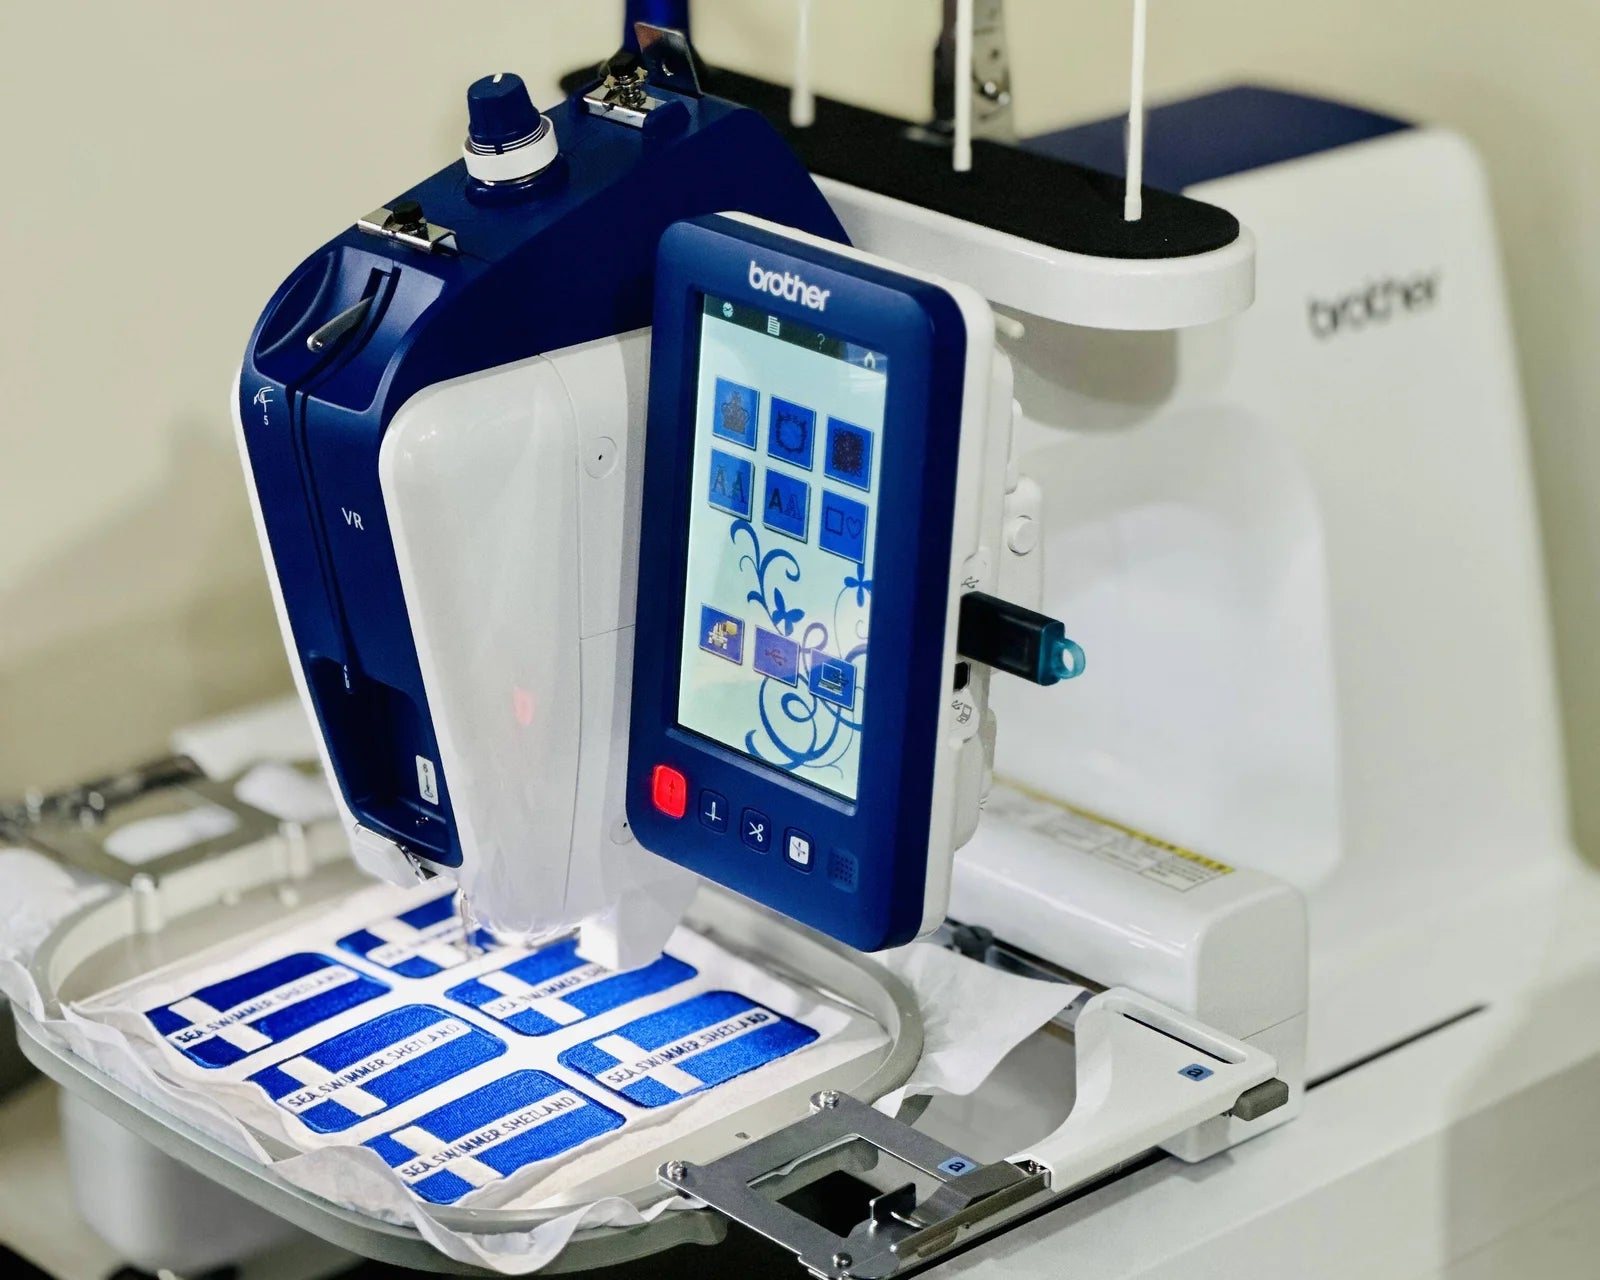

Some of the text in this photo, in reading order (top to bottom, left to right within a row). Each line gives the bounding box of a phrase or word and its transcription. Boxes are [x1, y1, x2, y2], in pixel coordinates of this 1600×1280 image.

[748, 260, 831, 312] brother
[263, 415, 269, 426] 5
[341, 507, 364, 531] VR
[174, 1028, 205, 1044] SEA
[207, 998, 273, 1031] SWIMMER
[287, 1022, 460, 1107] SEA SWIMMER SHETLAND
[607, 1012, 770, 1083] SEA SWIMMER SHETLAND
[401, 1096, 576, 1177] SEA SWIMMER SHETLAND
[948, 1161, 966, 1173] a
